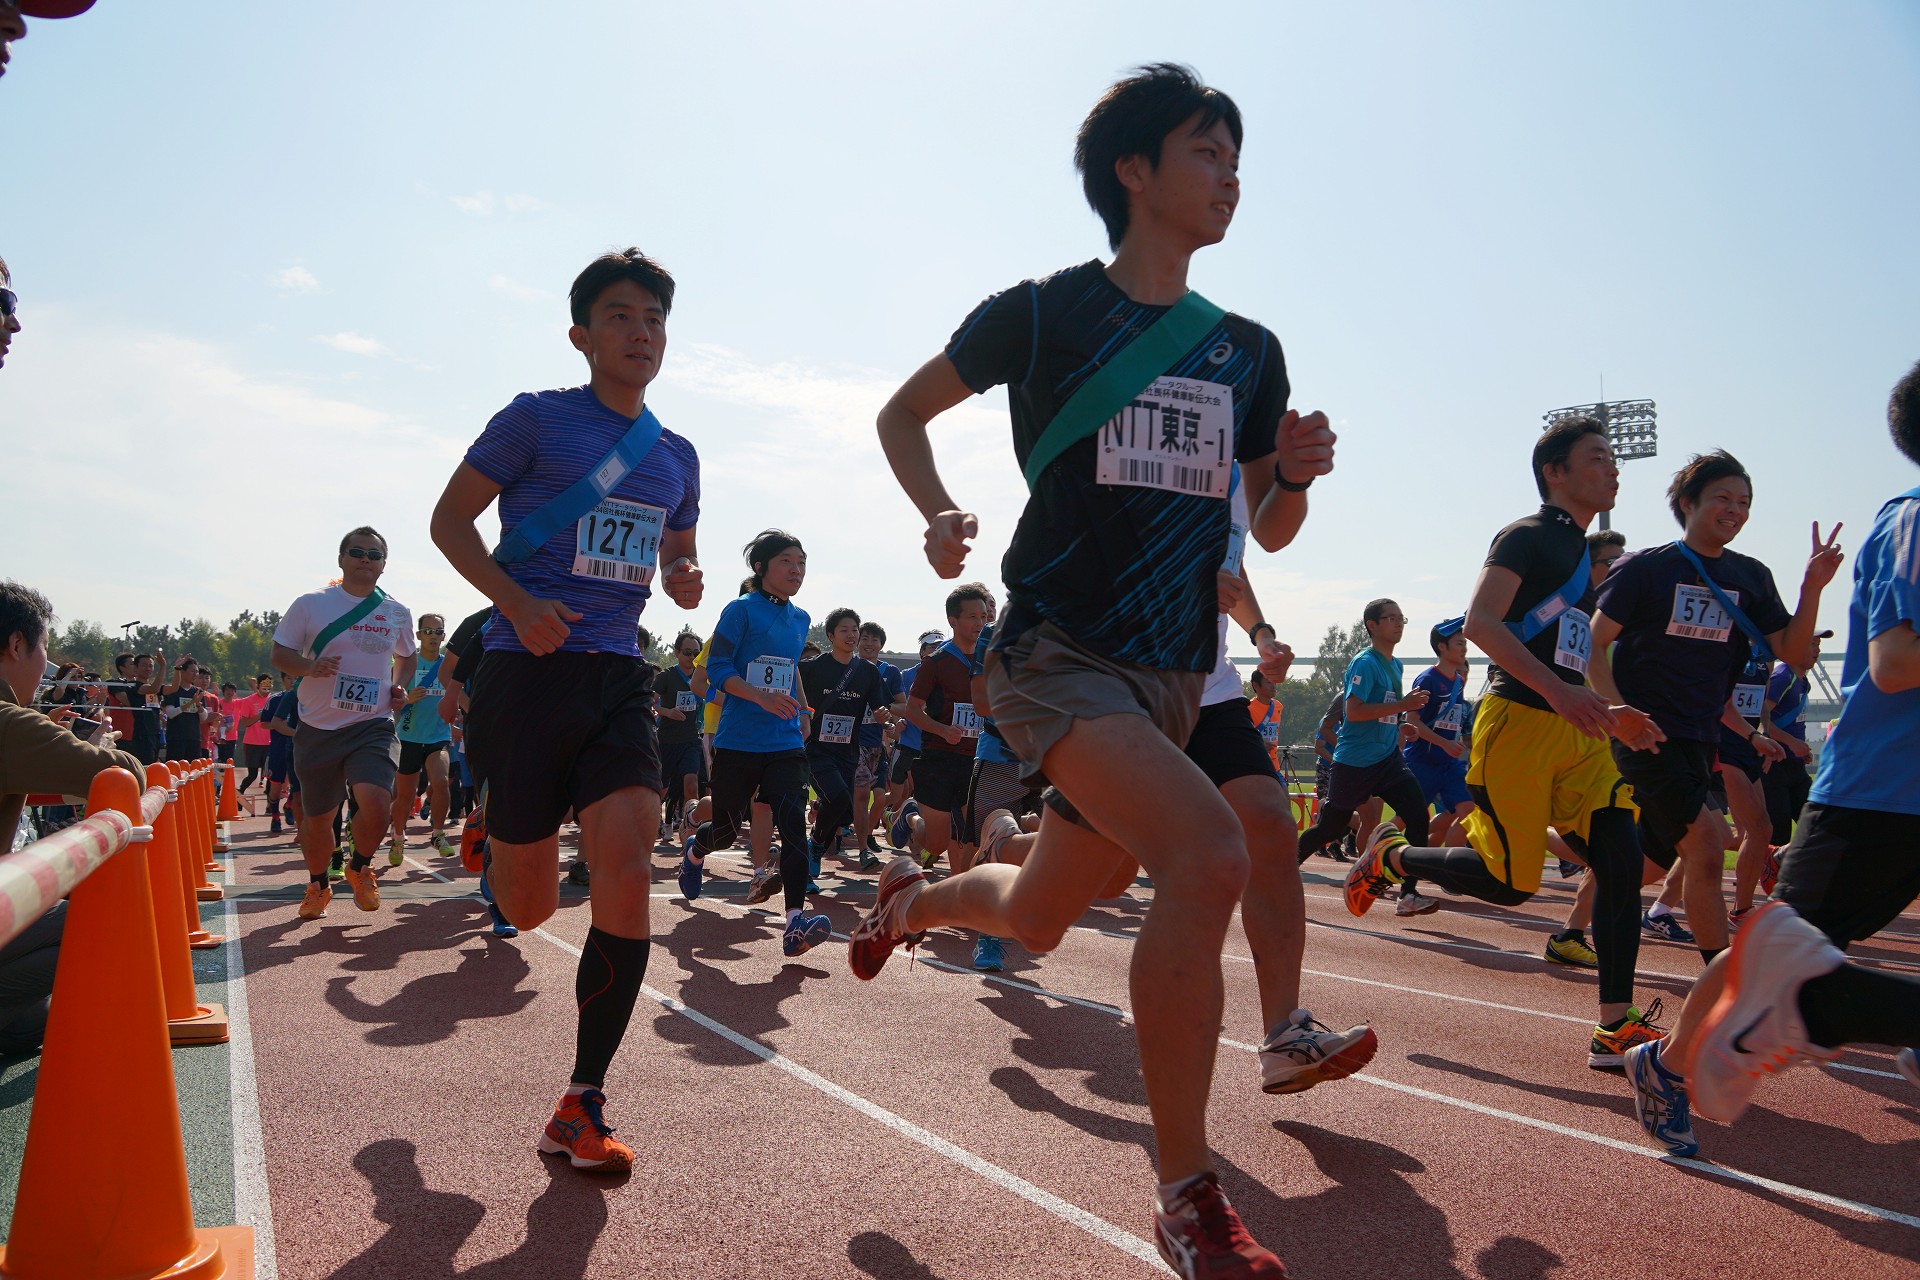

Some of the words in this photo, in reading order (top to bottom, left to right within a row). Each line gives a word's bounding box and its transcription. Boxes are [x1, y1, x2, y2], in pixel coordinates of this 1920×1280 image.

[588, 514, 646, 560] 127-1
[1683, 598, 1722, 625] 57-1
[764, 666, 785, 686] 8-1
[338, 681, 372, 703] 162-1
[827, 721, 847, 735] 92-1
